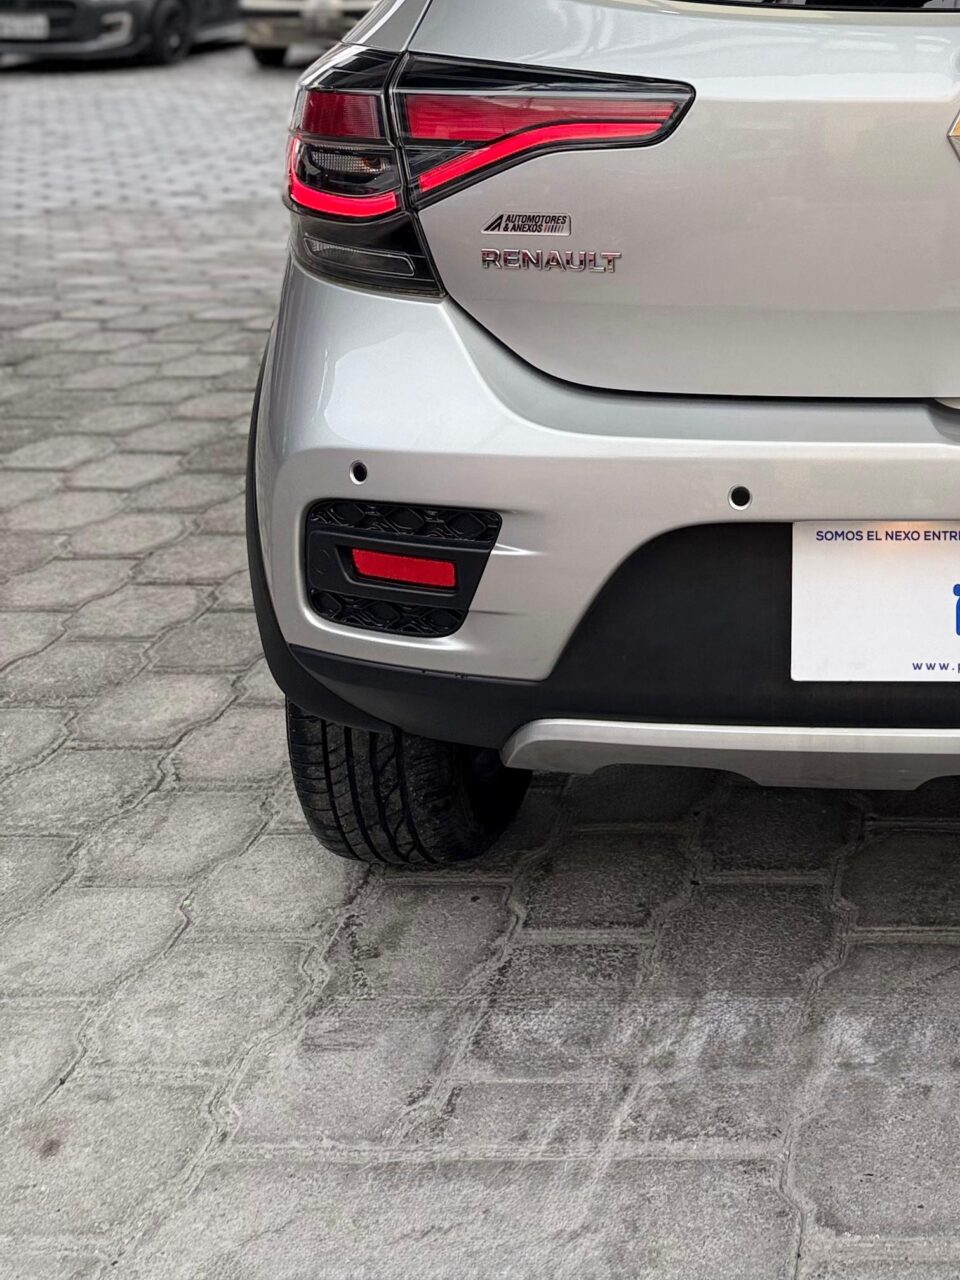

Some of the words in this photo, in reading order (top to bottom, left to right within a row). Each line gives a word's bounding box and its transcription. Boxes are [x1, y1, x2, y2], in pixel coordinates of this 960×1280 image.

[505, 214, 567, 224] AUTOMOTORES
[503, 224, 510, 232] &
[511, 224, 543, 233] ANEXOS
[480, 248, 622, 273] RENAULT
[816, 530, 864, 542] SOMOS
[867, 530, 882, 542] EL
[885, 530, 921, 542] NEXO
